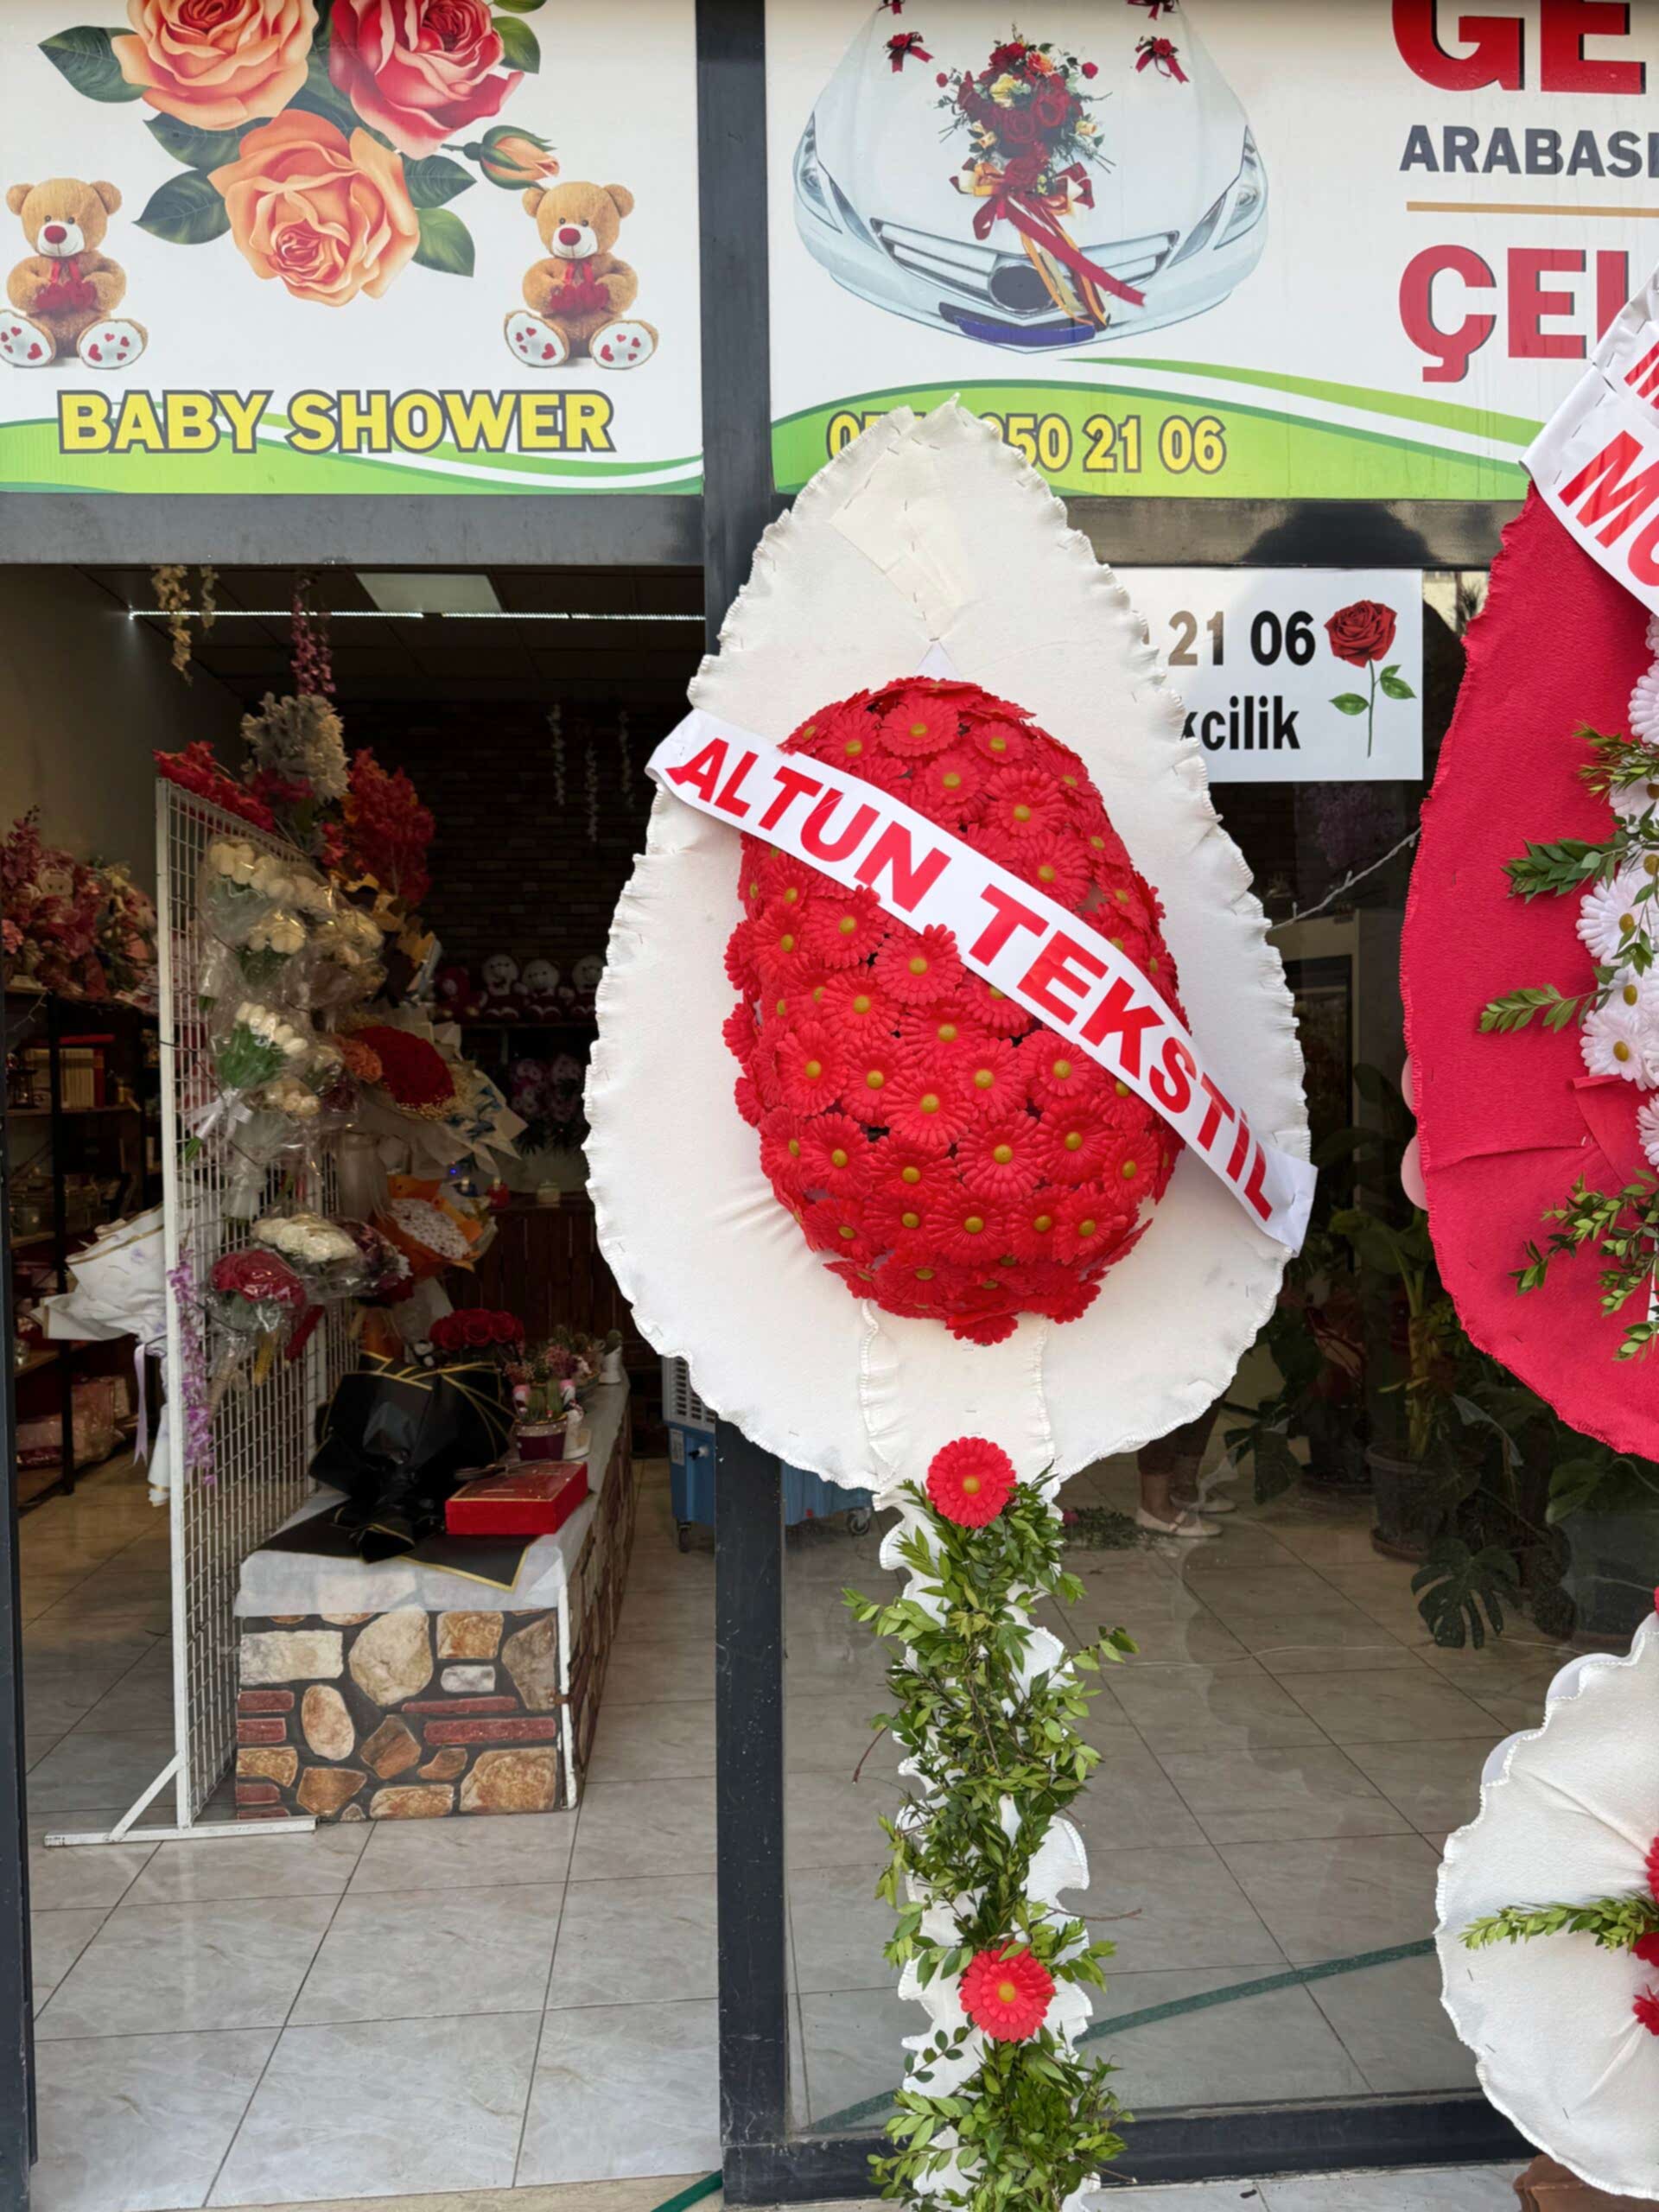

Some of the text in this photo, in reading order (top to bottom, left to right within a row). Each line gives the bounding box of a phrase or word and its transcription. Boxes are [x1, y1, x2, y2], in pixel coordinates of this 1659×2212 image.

[57, 389, 617, 454] BABY SHOWER
[977, 412, 1073, 474] 50
[1083, 414, 1141, 474] 21
[1159, 414, 1227, 474] 06
[1168, 610, 1224, 666] 21
[1250, 610, 1316, 666] 06
[665, 737, 1273, 1222] ALTUN TEKSTİL
